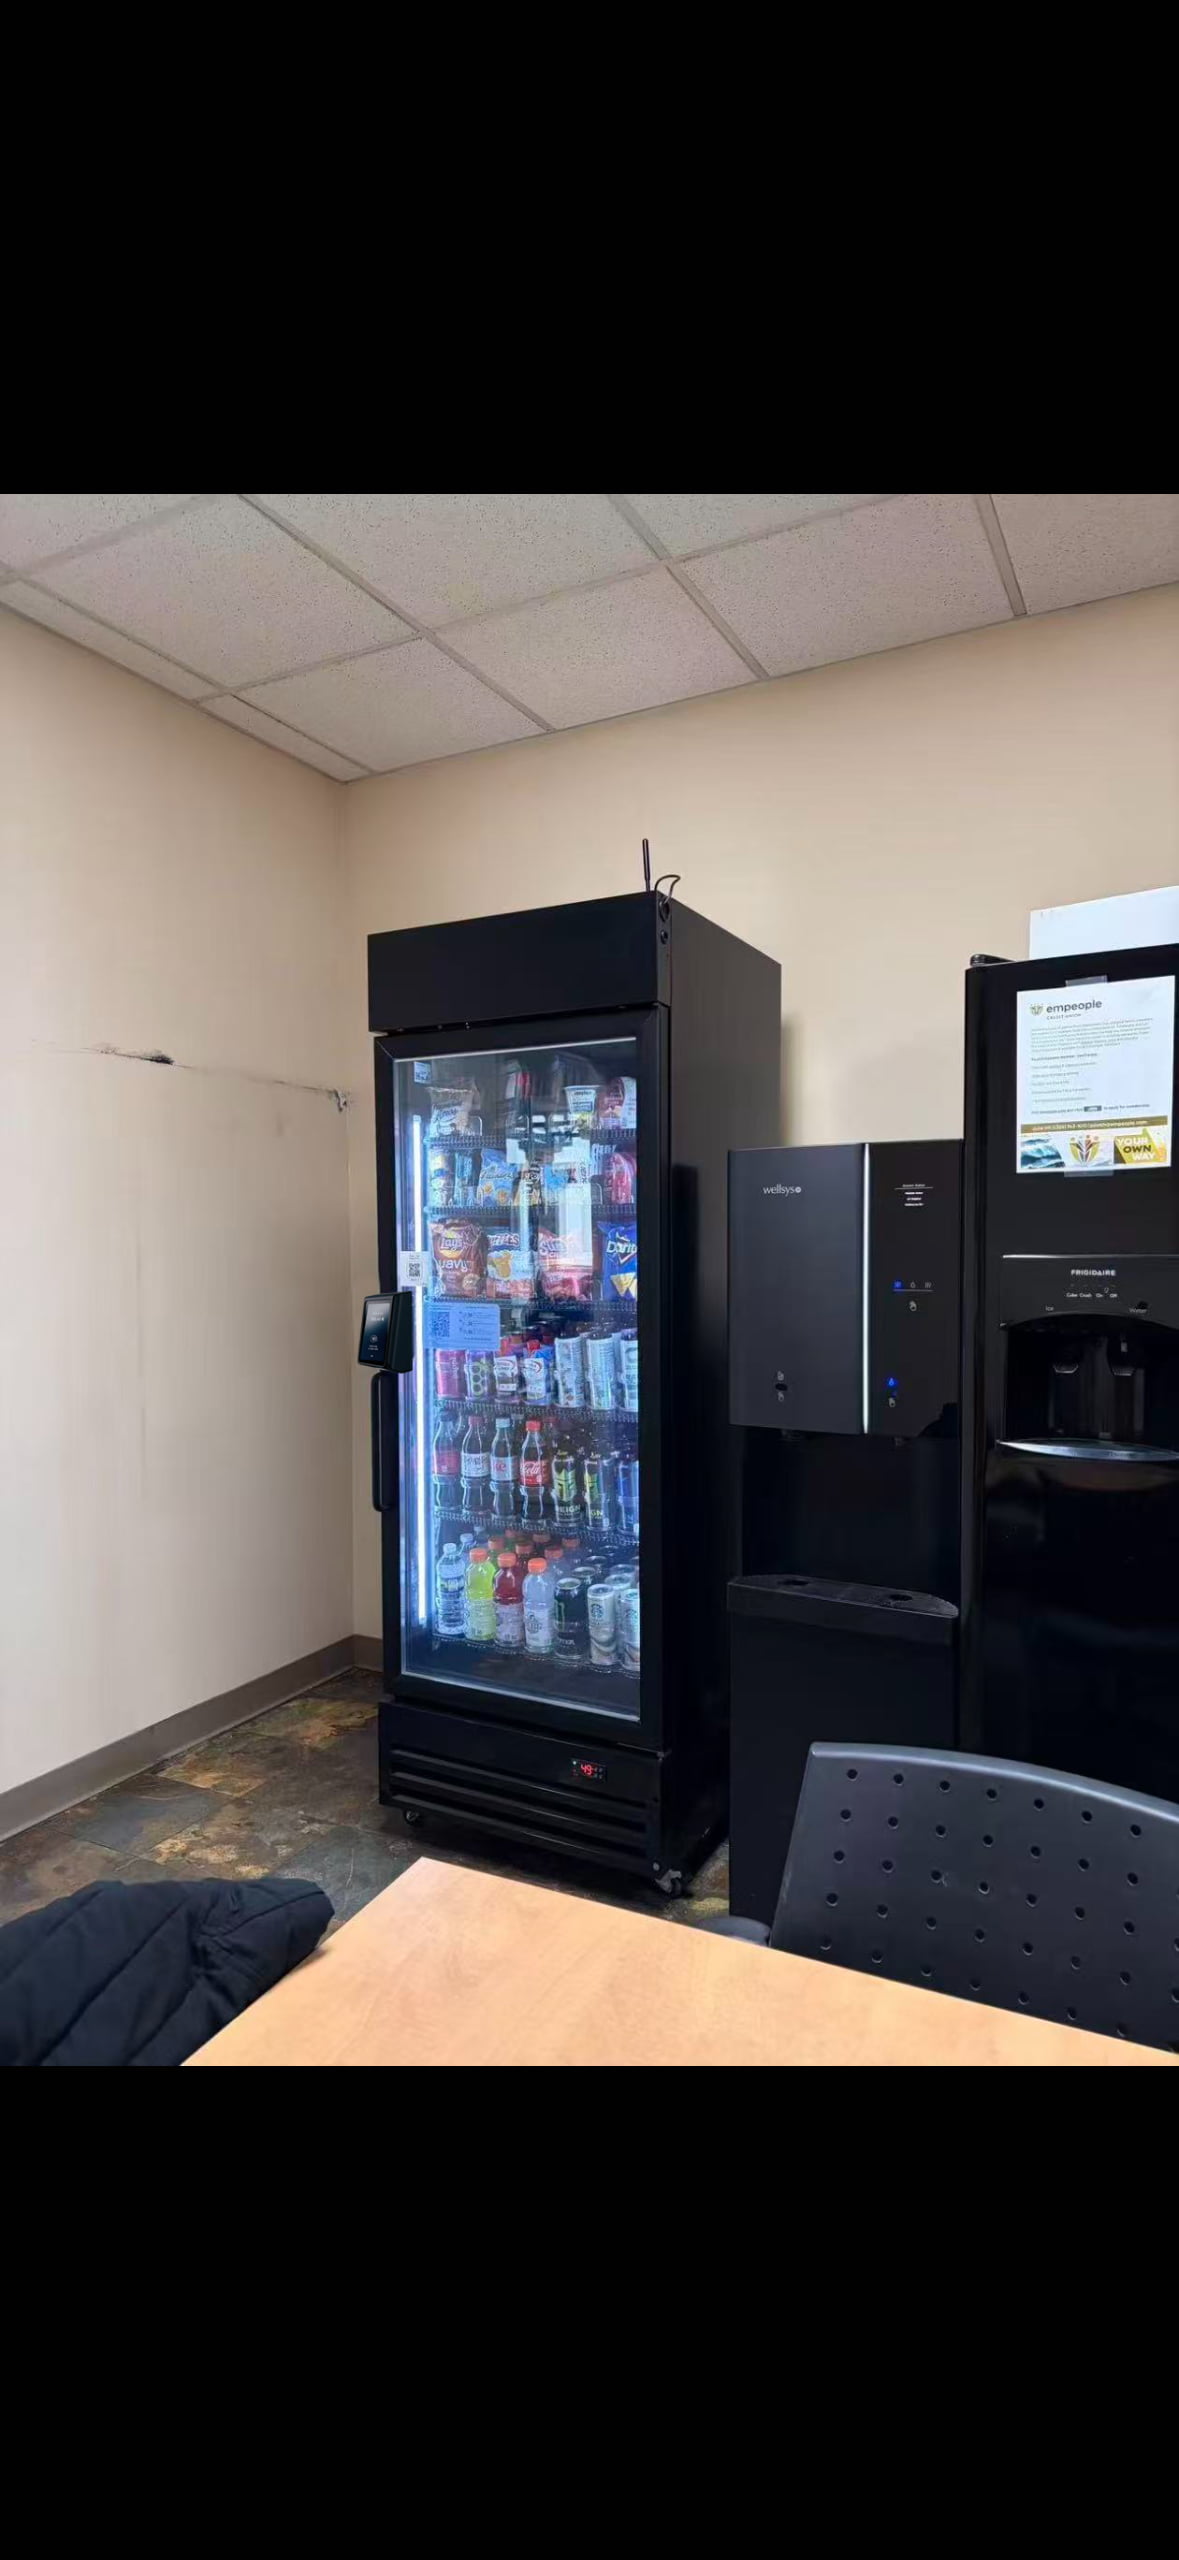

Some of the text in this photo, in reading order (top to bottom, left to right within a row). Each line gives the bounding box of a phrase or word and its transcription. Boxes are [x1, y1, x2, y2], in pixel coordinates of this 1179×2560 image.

[1046, 999, 1103, 1014] empeople
[1117, 1137, 1149, 1146] YOUR
[1123, 1145, 1152, 1153] OWN
[1132, 1153, 1156, 1161] WAY
[762, 1183, 796, 1197] wellsys
[1070, 1269, 1116, 1277] FRIGIDAIRE
[580, 1764, 592, 1775] 49
